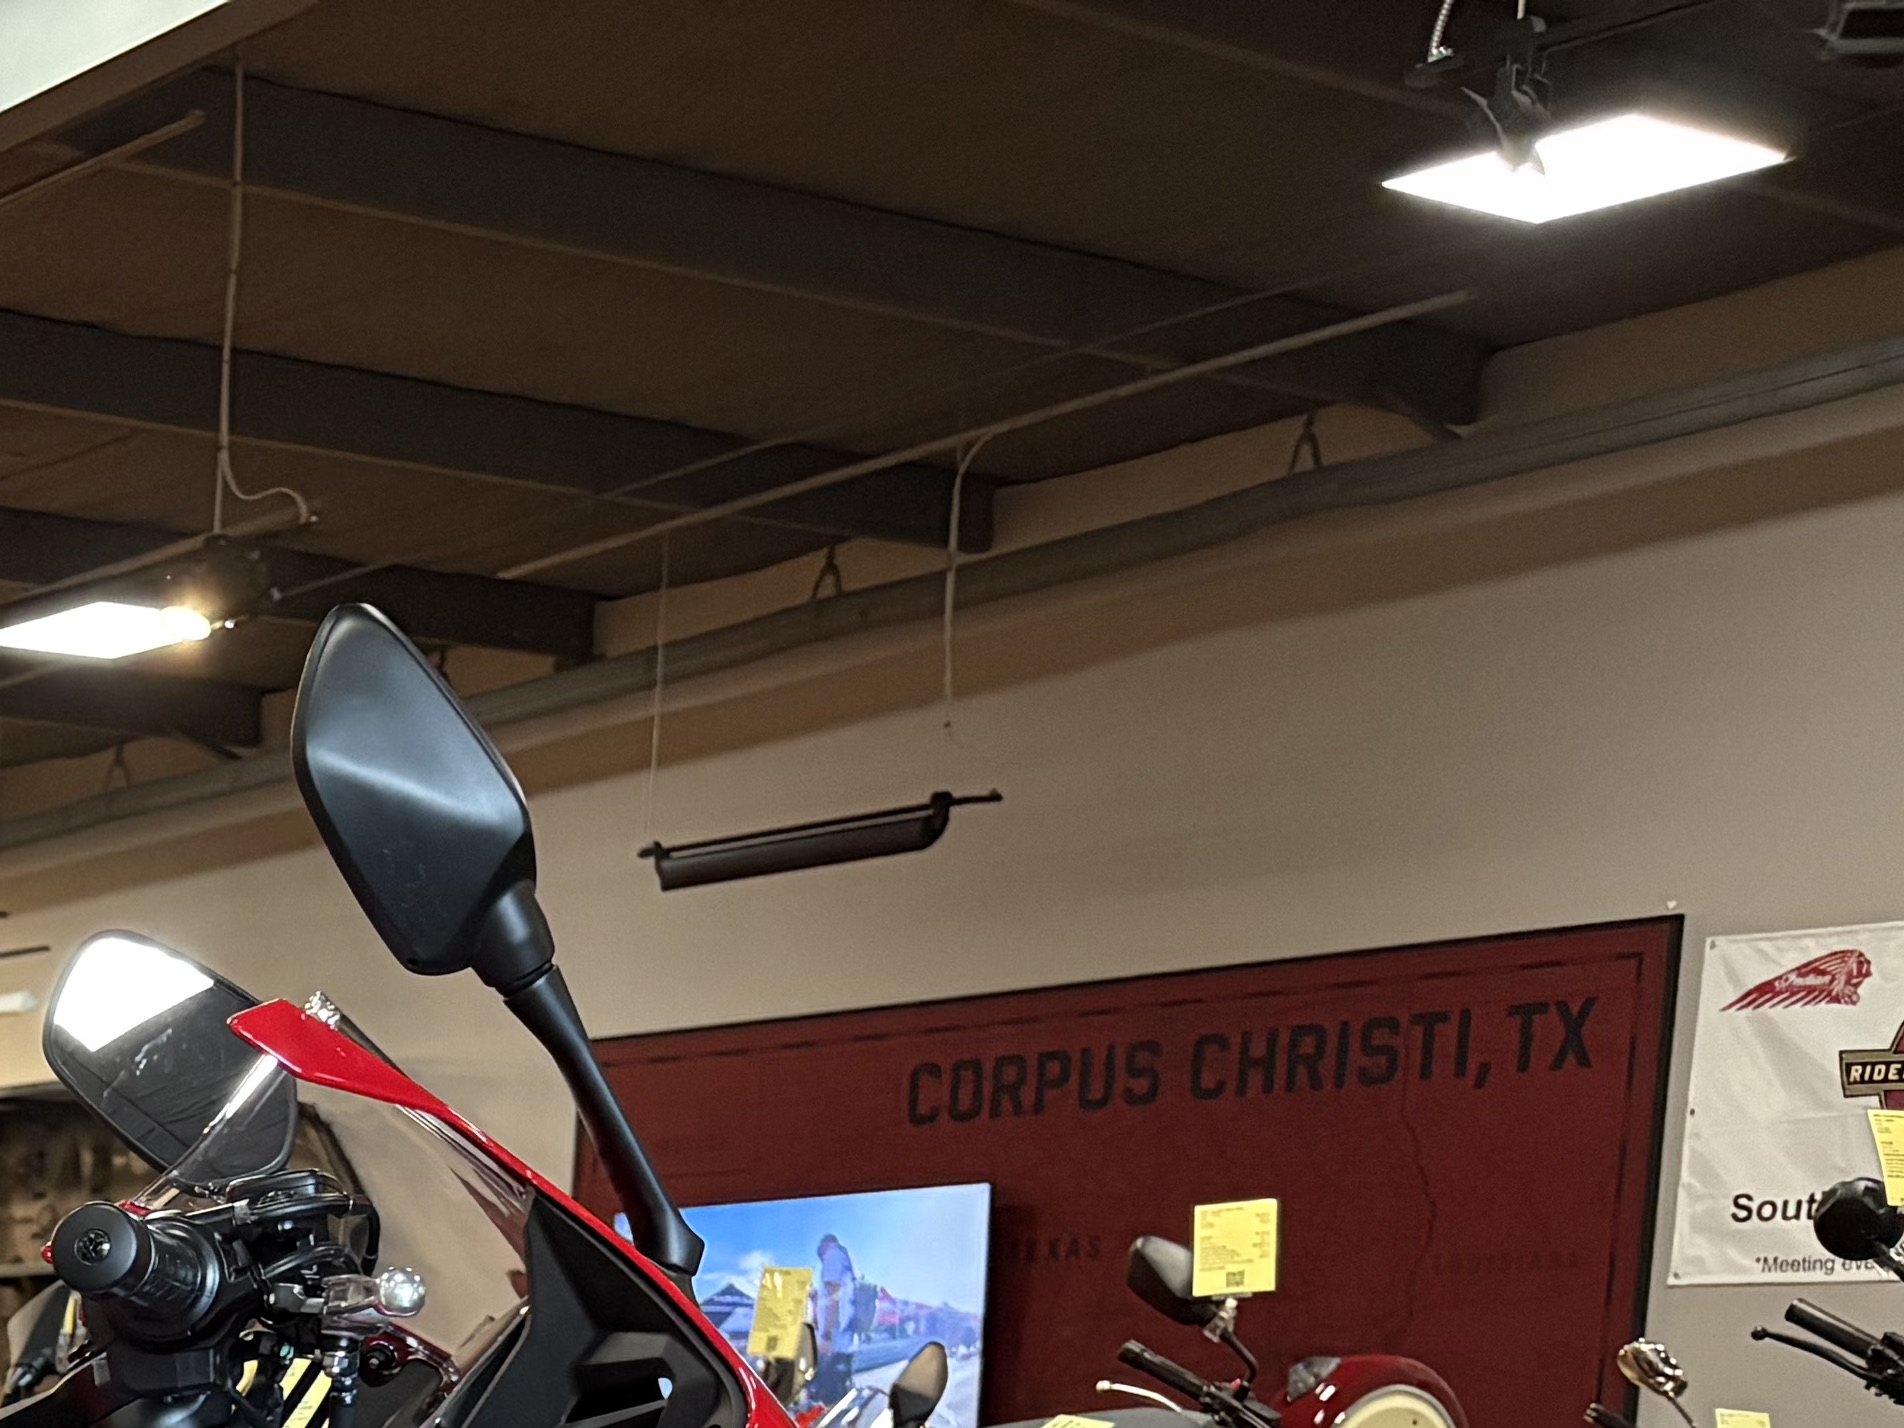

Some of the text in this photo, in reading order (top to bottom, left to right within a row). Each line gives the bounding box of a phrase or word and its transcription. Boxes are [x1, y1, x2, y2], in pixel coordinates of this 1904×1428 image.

[908, 996, 1597, 1127] CORPUS CHRISTI, TX
[1849, 1061, 1904, 1083] RIDE
[1730, 1191, 1822, 1224] Sout
